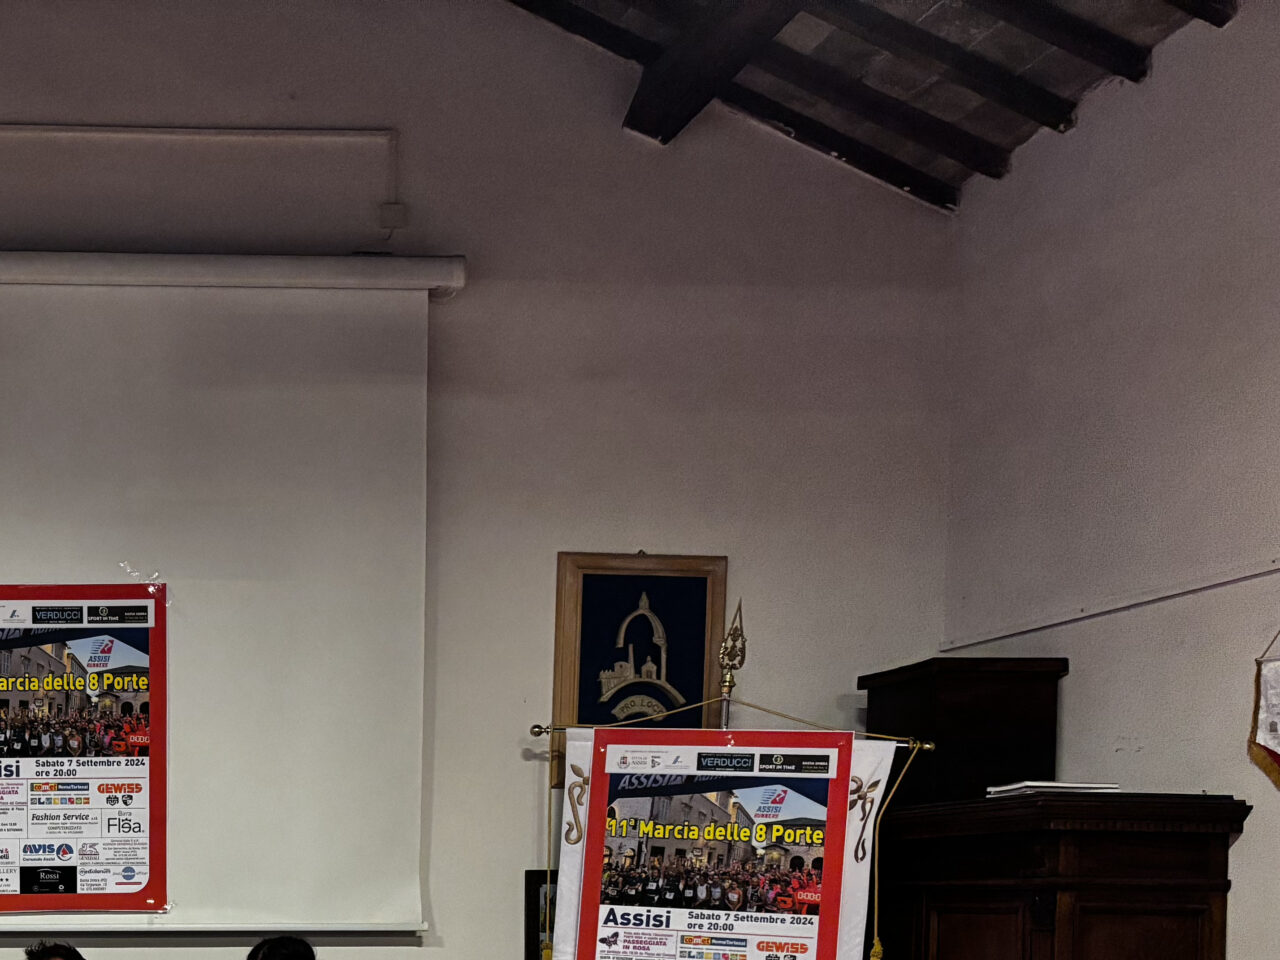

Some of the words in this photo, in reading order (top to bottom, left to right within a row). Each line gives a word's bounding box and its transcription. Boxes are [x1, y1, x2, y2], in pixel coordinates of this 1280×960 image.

[43, 673, 84, 691] delle
[89, 674, 99, 690] 8
[104, 673, 148, 690] Porte
[638, 819, 700, 841] Marcia
[703, 821, 751, 842] delle
[754, 824, 767, 842] 8
[771, 824, 824, 845] Porte
[22, 844, 55, 854] AVIS
[603, 907, 671, 928] Assisi
[688, 911, 721, 921] Sabato
[733, 913, 786, 924] Settembre
[790, 916, 814, 925] 2024
[707, 923, 734, 932] 20:00
